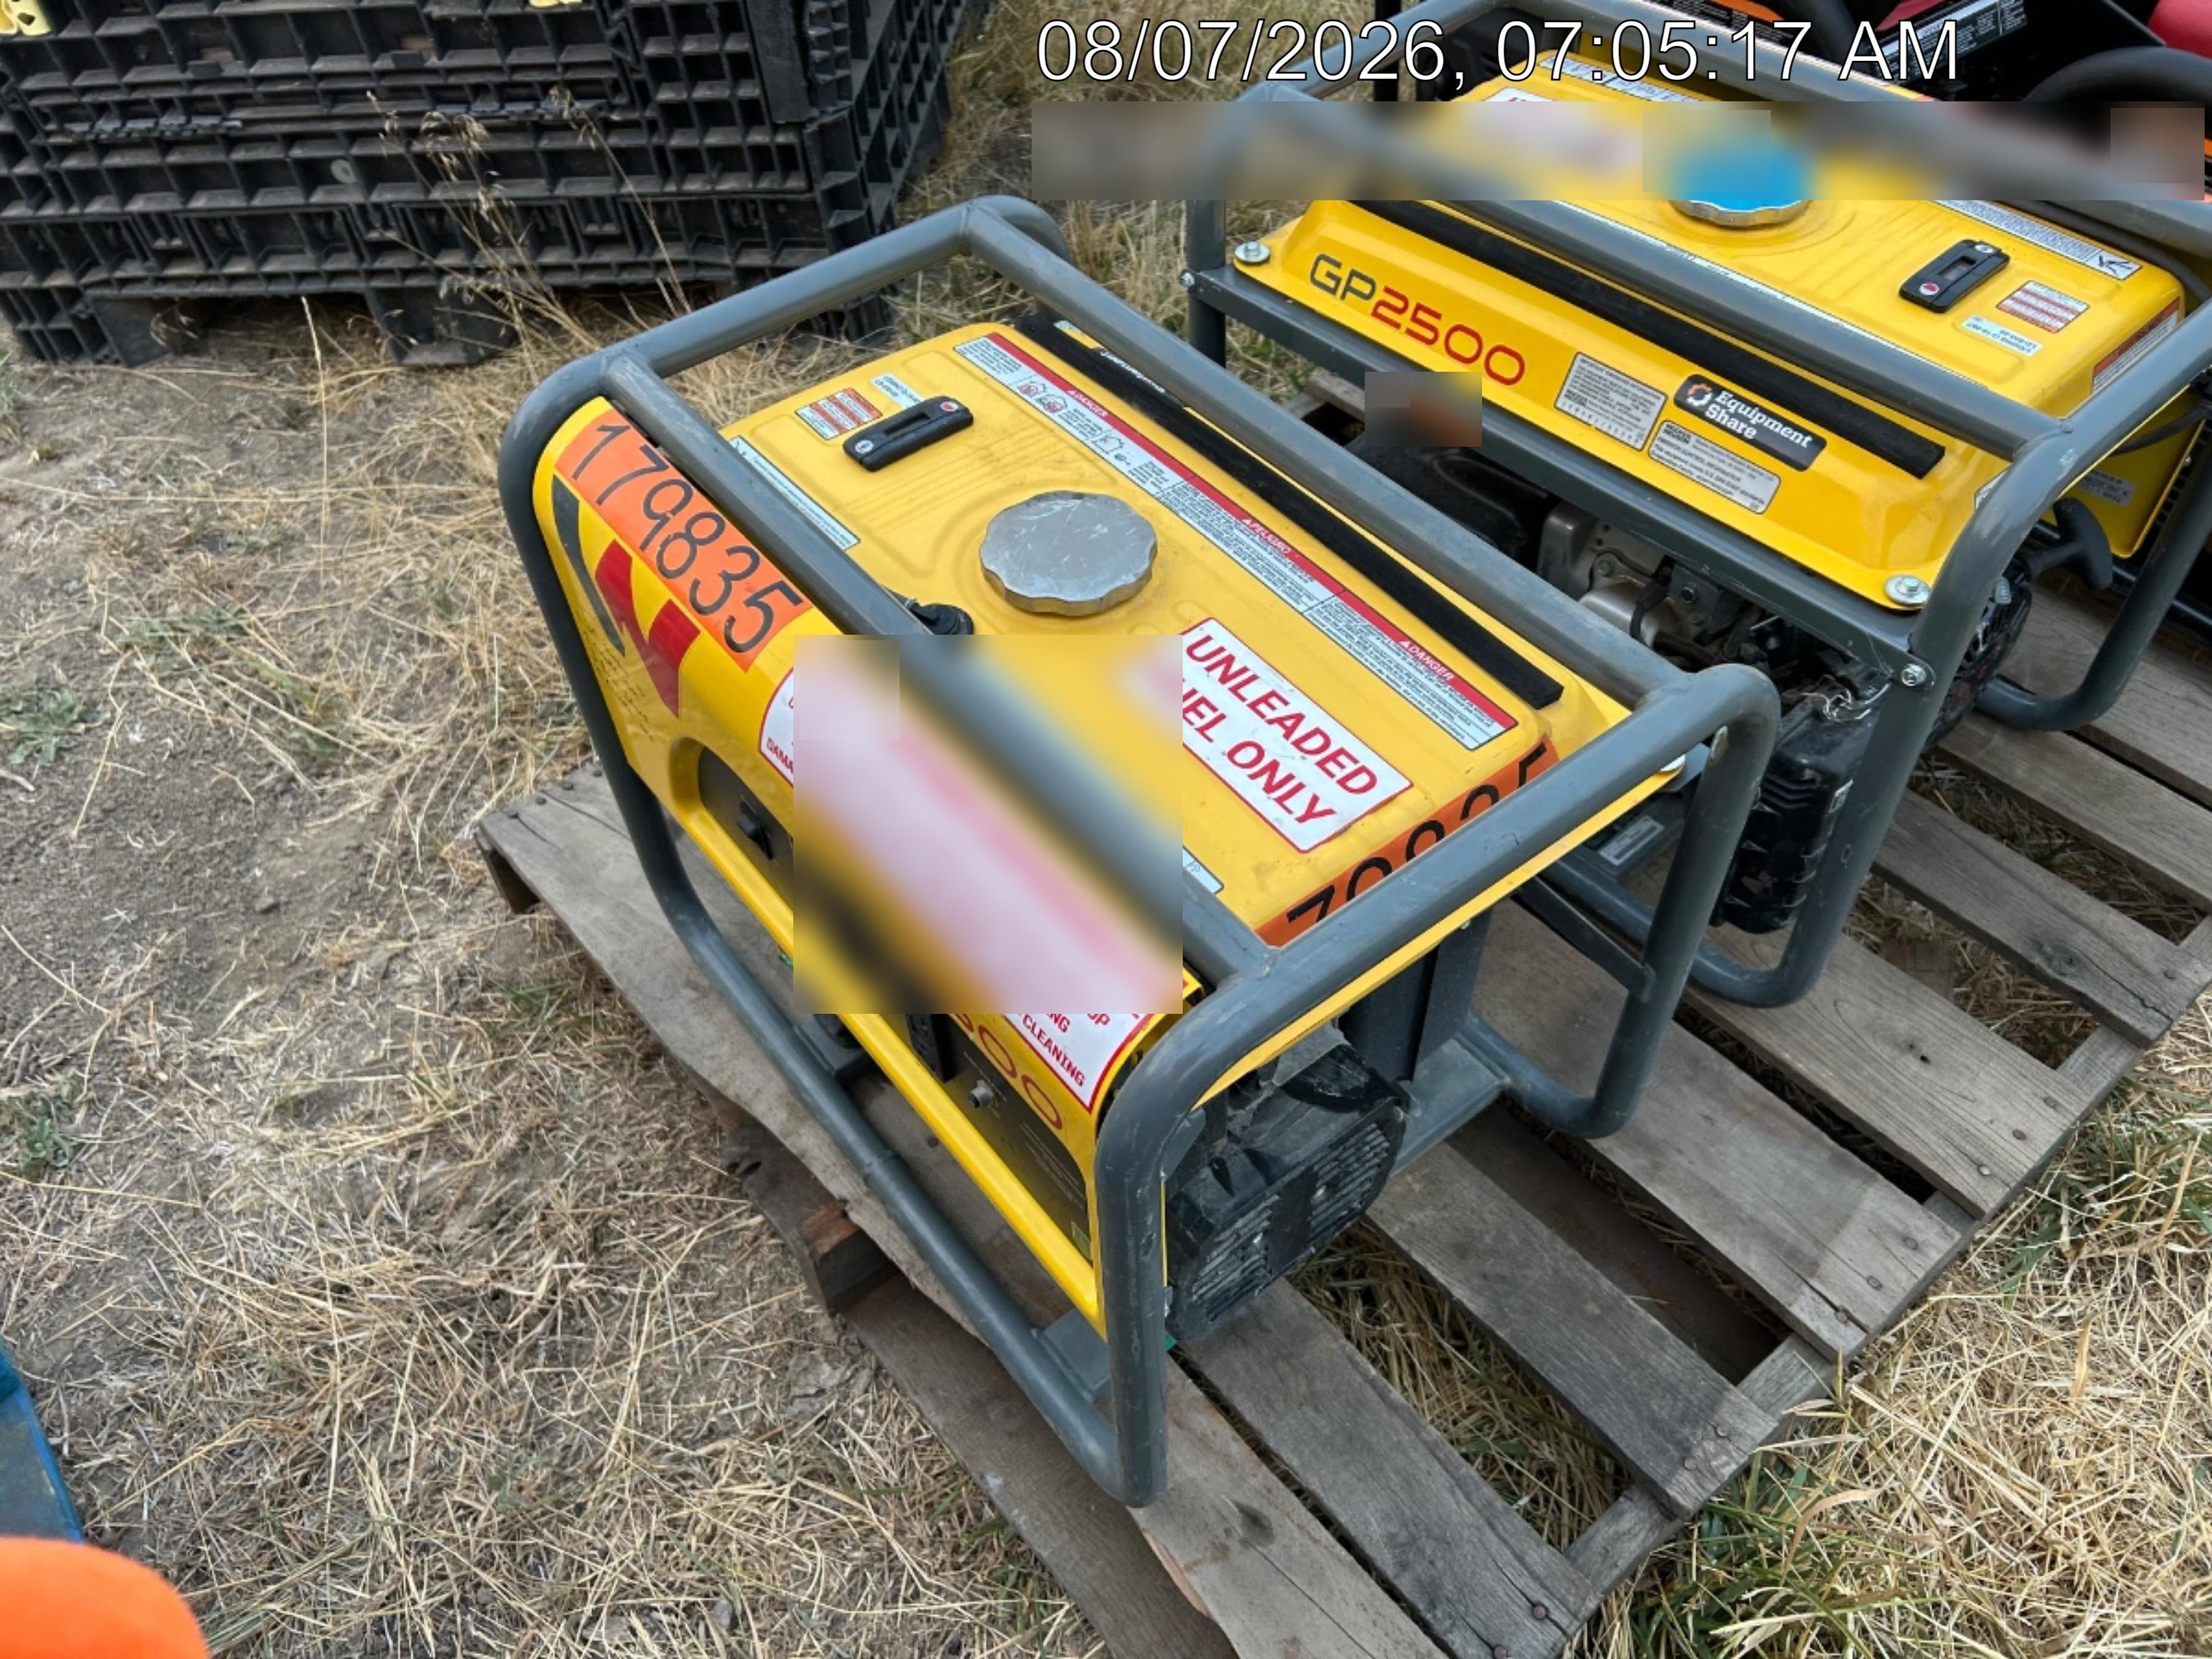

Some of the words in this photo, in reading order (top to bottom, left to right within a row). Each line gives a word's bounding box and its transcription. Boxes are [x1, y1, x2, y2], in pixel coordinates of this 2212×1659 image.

[1309, 253, 1526, 386] GP2500
[1704, 404, 1757, 441] Share
[1715, 390, 1814, 449] Equipment
[571, 424, 802, 654] 179835
[1408, 645, 1455, 681] DANGER
[1186, 635, 1378, 795] UNLEADED
[1226, 740, 1336, 824] ONLY
[1022, 1015, 1086, 1087] CLEANING
